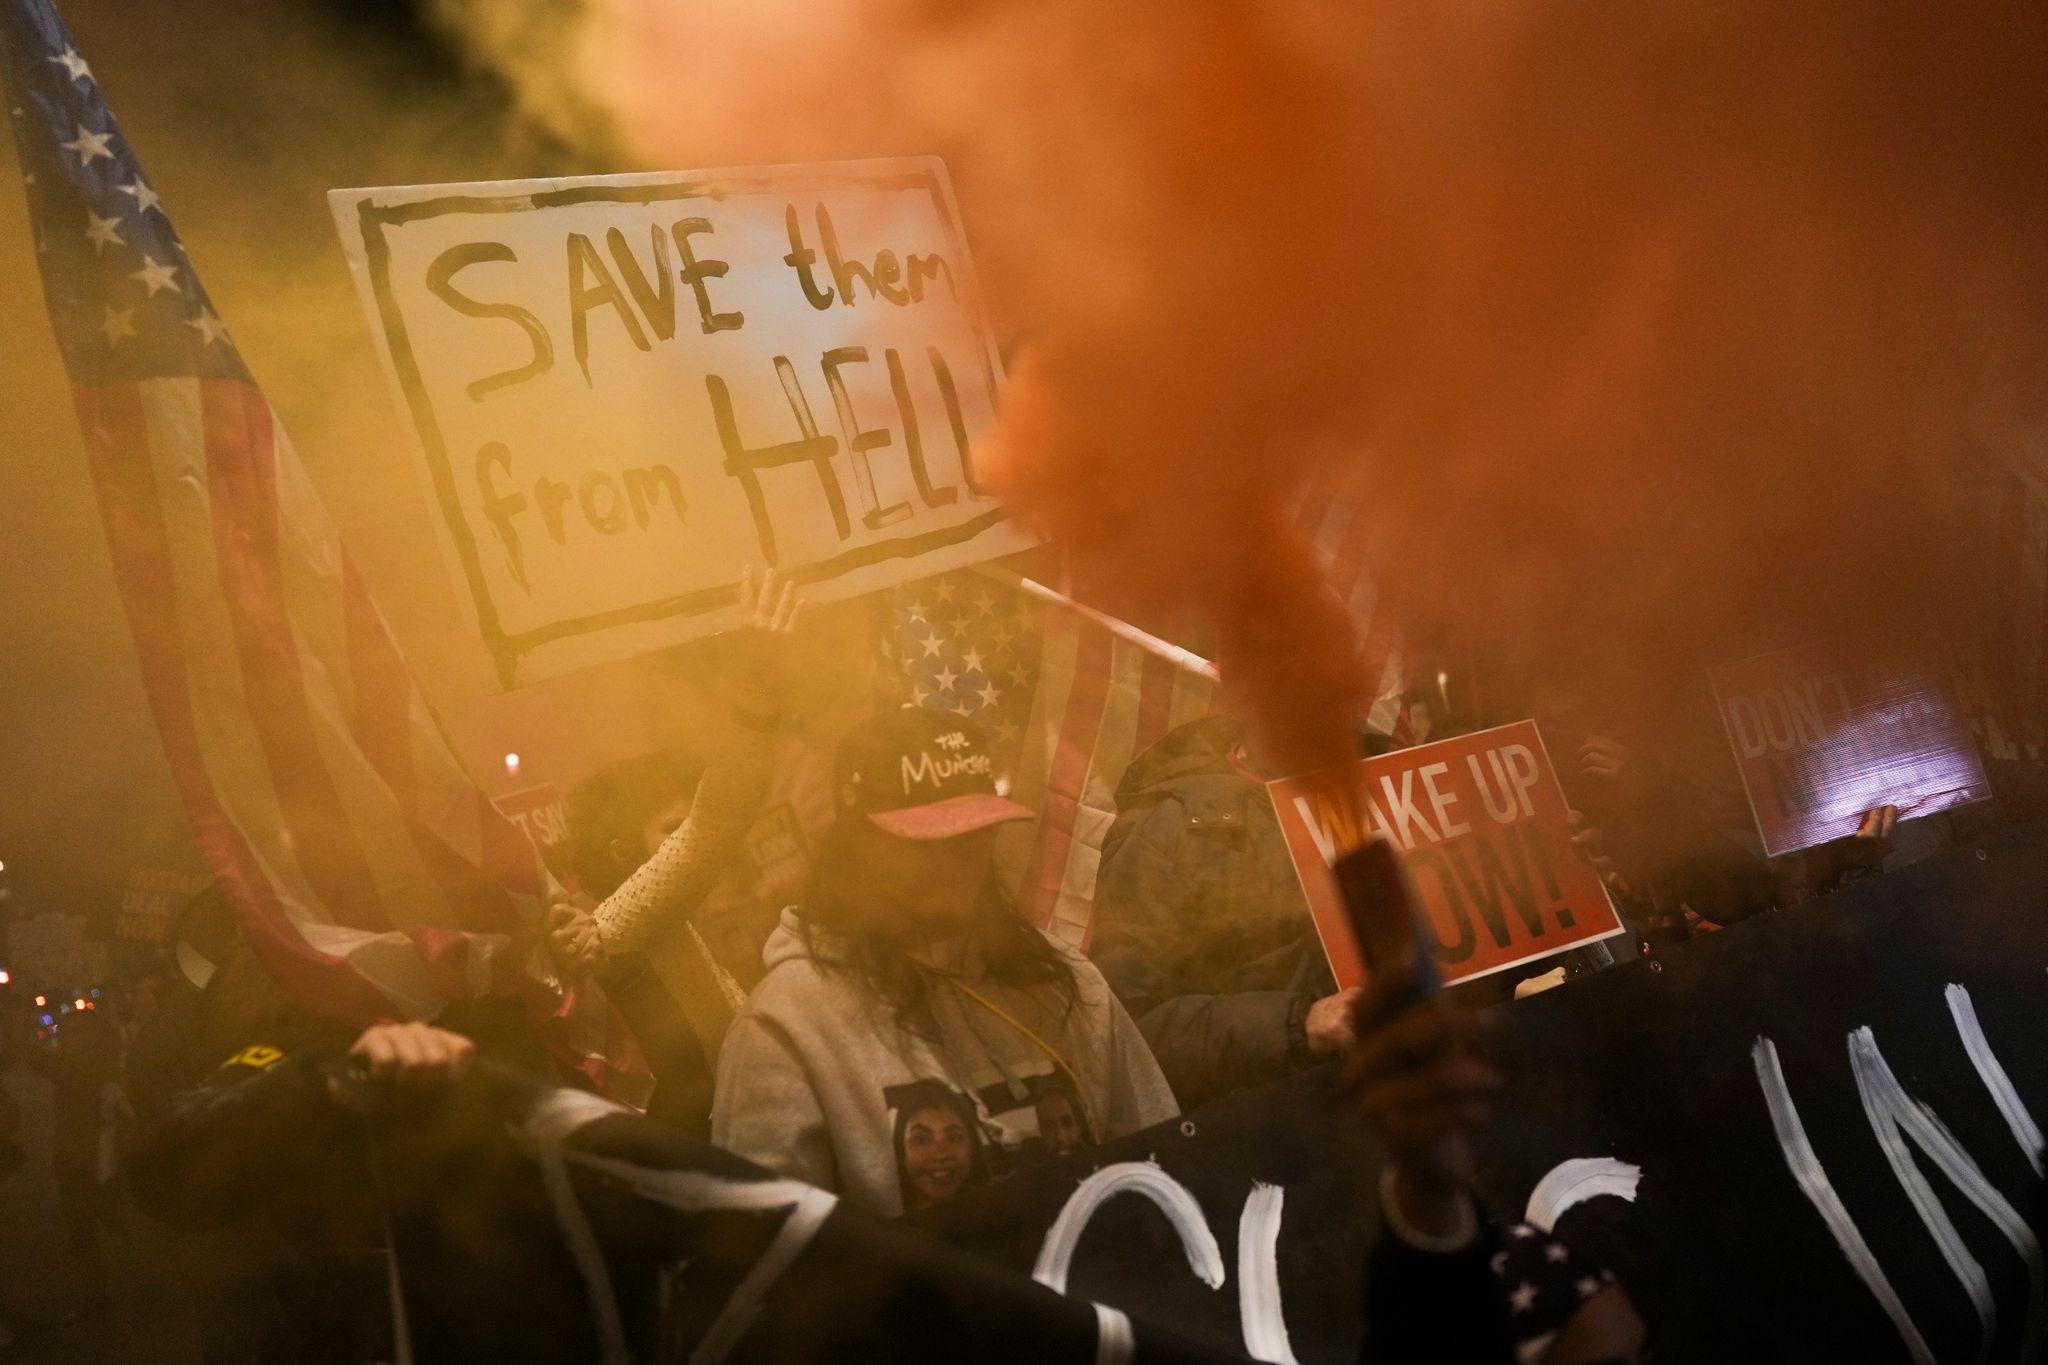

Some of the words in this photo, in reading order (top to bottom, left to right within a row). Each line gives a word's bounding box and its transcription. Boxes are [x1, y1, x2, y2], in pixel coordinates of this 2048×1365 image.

[426, 217, 744, 400] SAVE
[784, 201, 958, 310] them
[477, 442, 687, 595] from
[706, 347, 1000, 566] HELL
[1293, 762, 1472, 869] WAKE
[1467, 744, 1539, 823] UP
[1404, 826, 1576, 964] OW!
